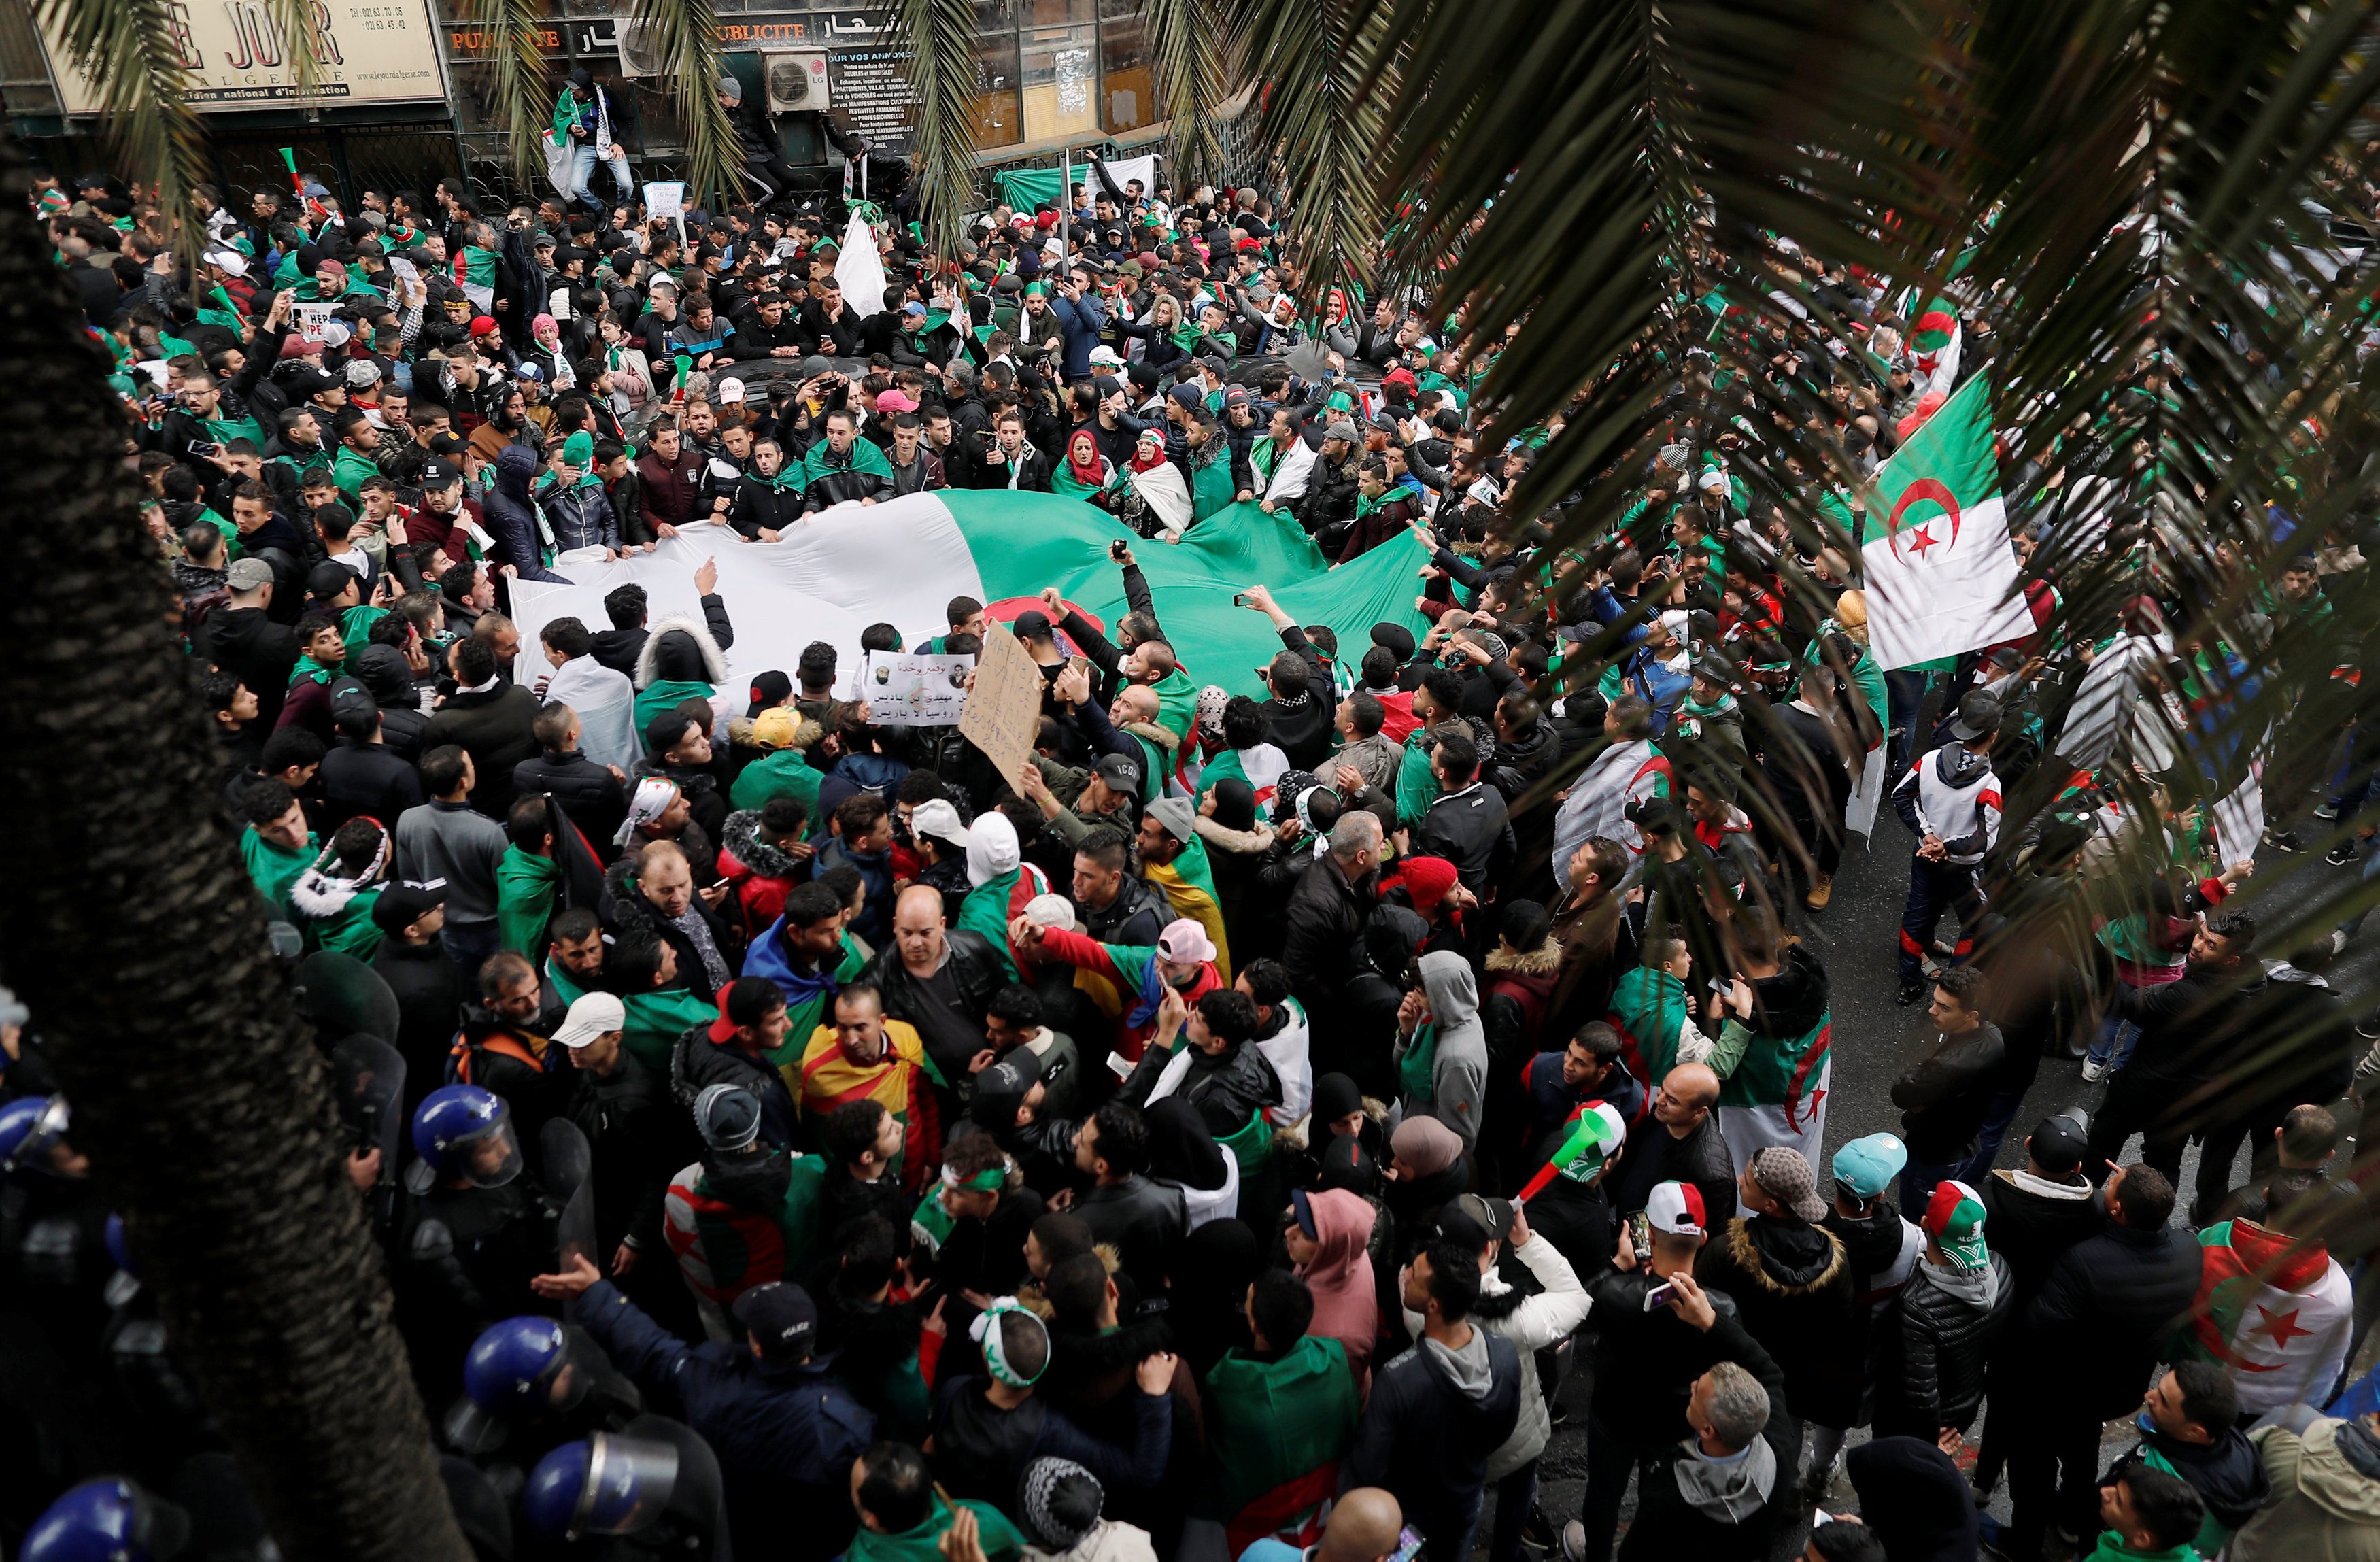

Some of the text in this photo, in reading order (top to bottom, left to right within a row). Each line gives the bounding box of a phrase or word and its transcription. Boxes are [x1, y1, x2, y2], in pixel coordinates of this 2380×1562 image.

[703, 24, 806, 41] UBLICITE
[871, 51, 921, 60] ANNON
[356, 69, 430, 82] www.lejourdalgerie.com
[812, 75, 824, 84] LG
[223, 88, 269, 99] national
[924, 662, 947, 675] نوفمبر
[874, 693, 903, 704] باديس
[909, 694, 920, 704] بن
[925, 694, 952, 704] مهيدي
[877, 709, 907, 720] باريس
[913, 709, 919, 717] لا
[926, 709, 953, 720] روسيا
